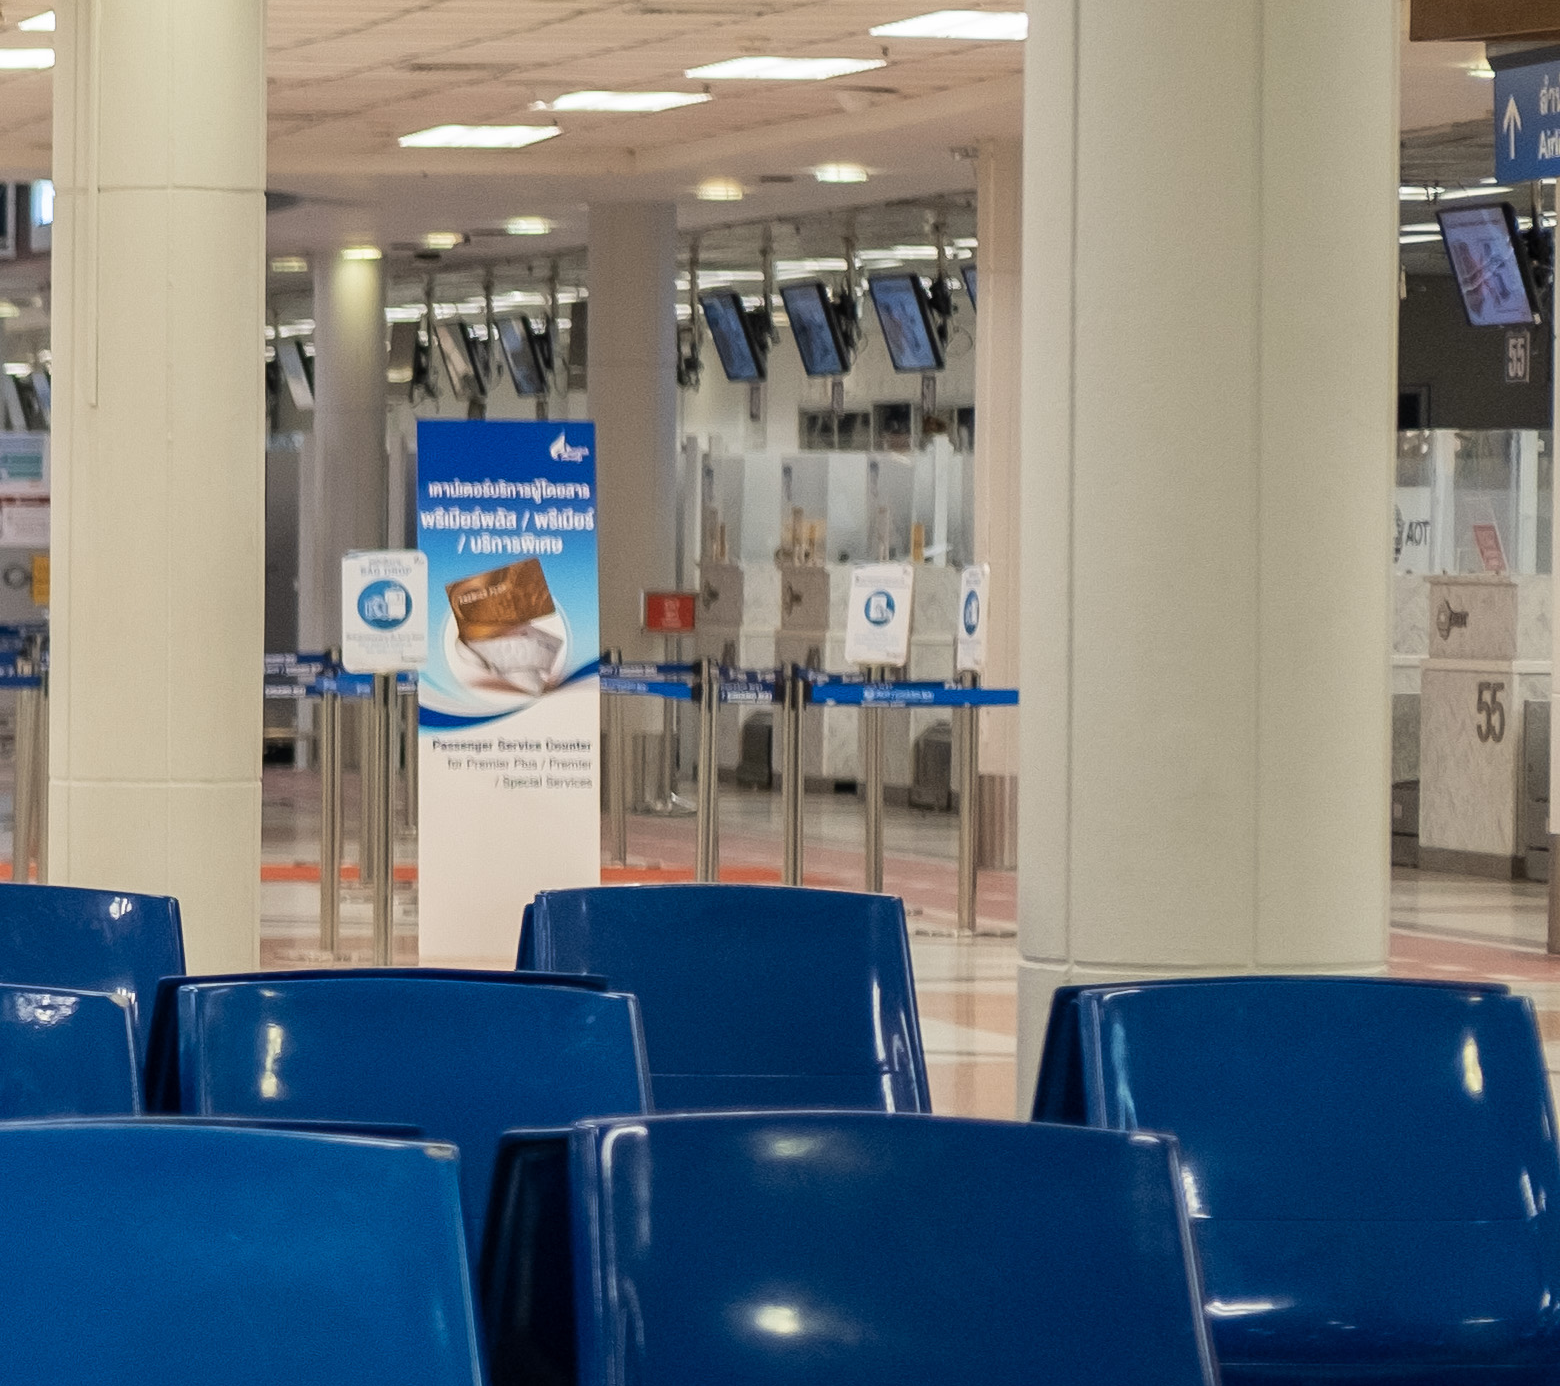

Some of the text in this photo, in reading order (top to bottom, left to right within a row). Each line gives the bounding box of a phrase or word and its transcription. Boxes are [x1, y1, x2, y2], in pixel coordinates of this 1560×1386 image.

[1476, 681, 1506, 744] 55
[432, 738, 592, 753] Passenger Service Counter
